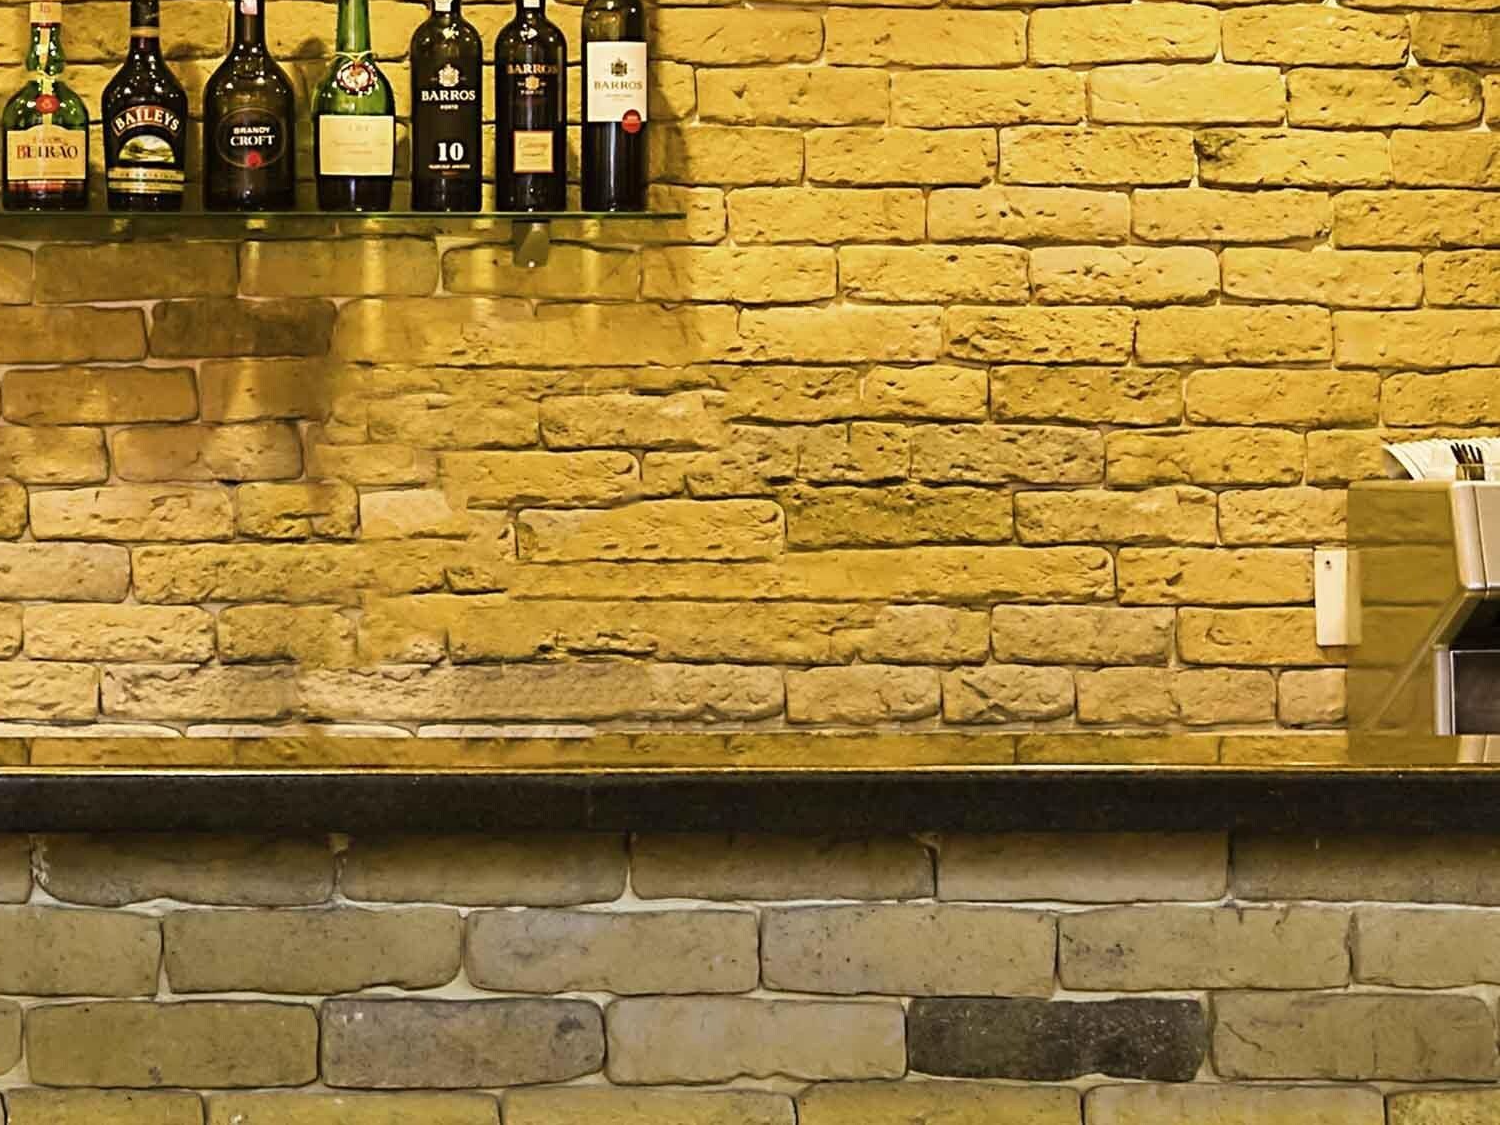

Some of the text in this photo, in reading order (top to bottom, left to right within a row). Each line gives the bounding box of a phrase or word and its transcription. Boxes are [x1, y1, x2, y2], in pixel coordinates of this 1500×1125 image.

[593, 80, 644, 91] BARROS
[421, 90, 477, 102] BARROS
[115, 108, 180, 131] BAILEYS
[233, 126, 271, 135] BRANDY
[230, 135, 276, 146] CROFT
[438, 142, 464, 162] 10
